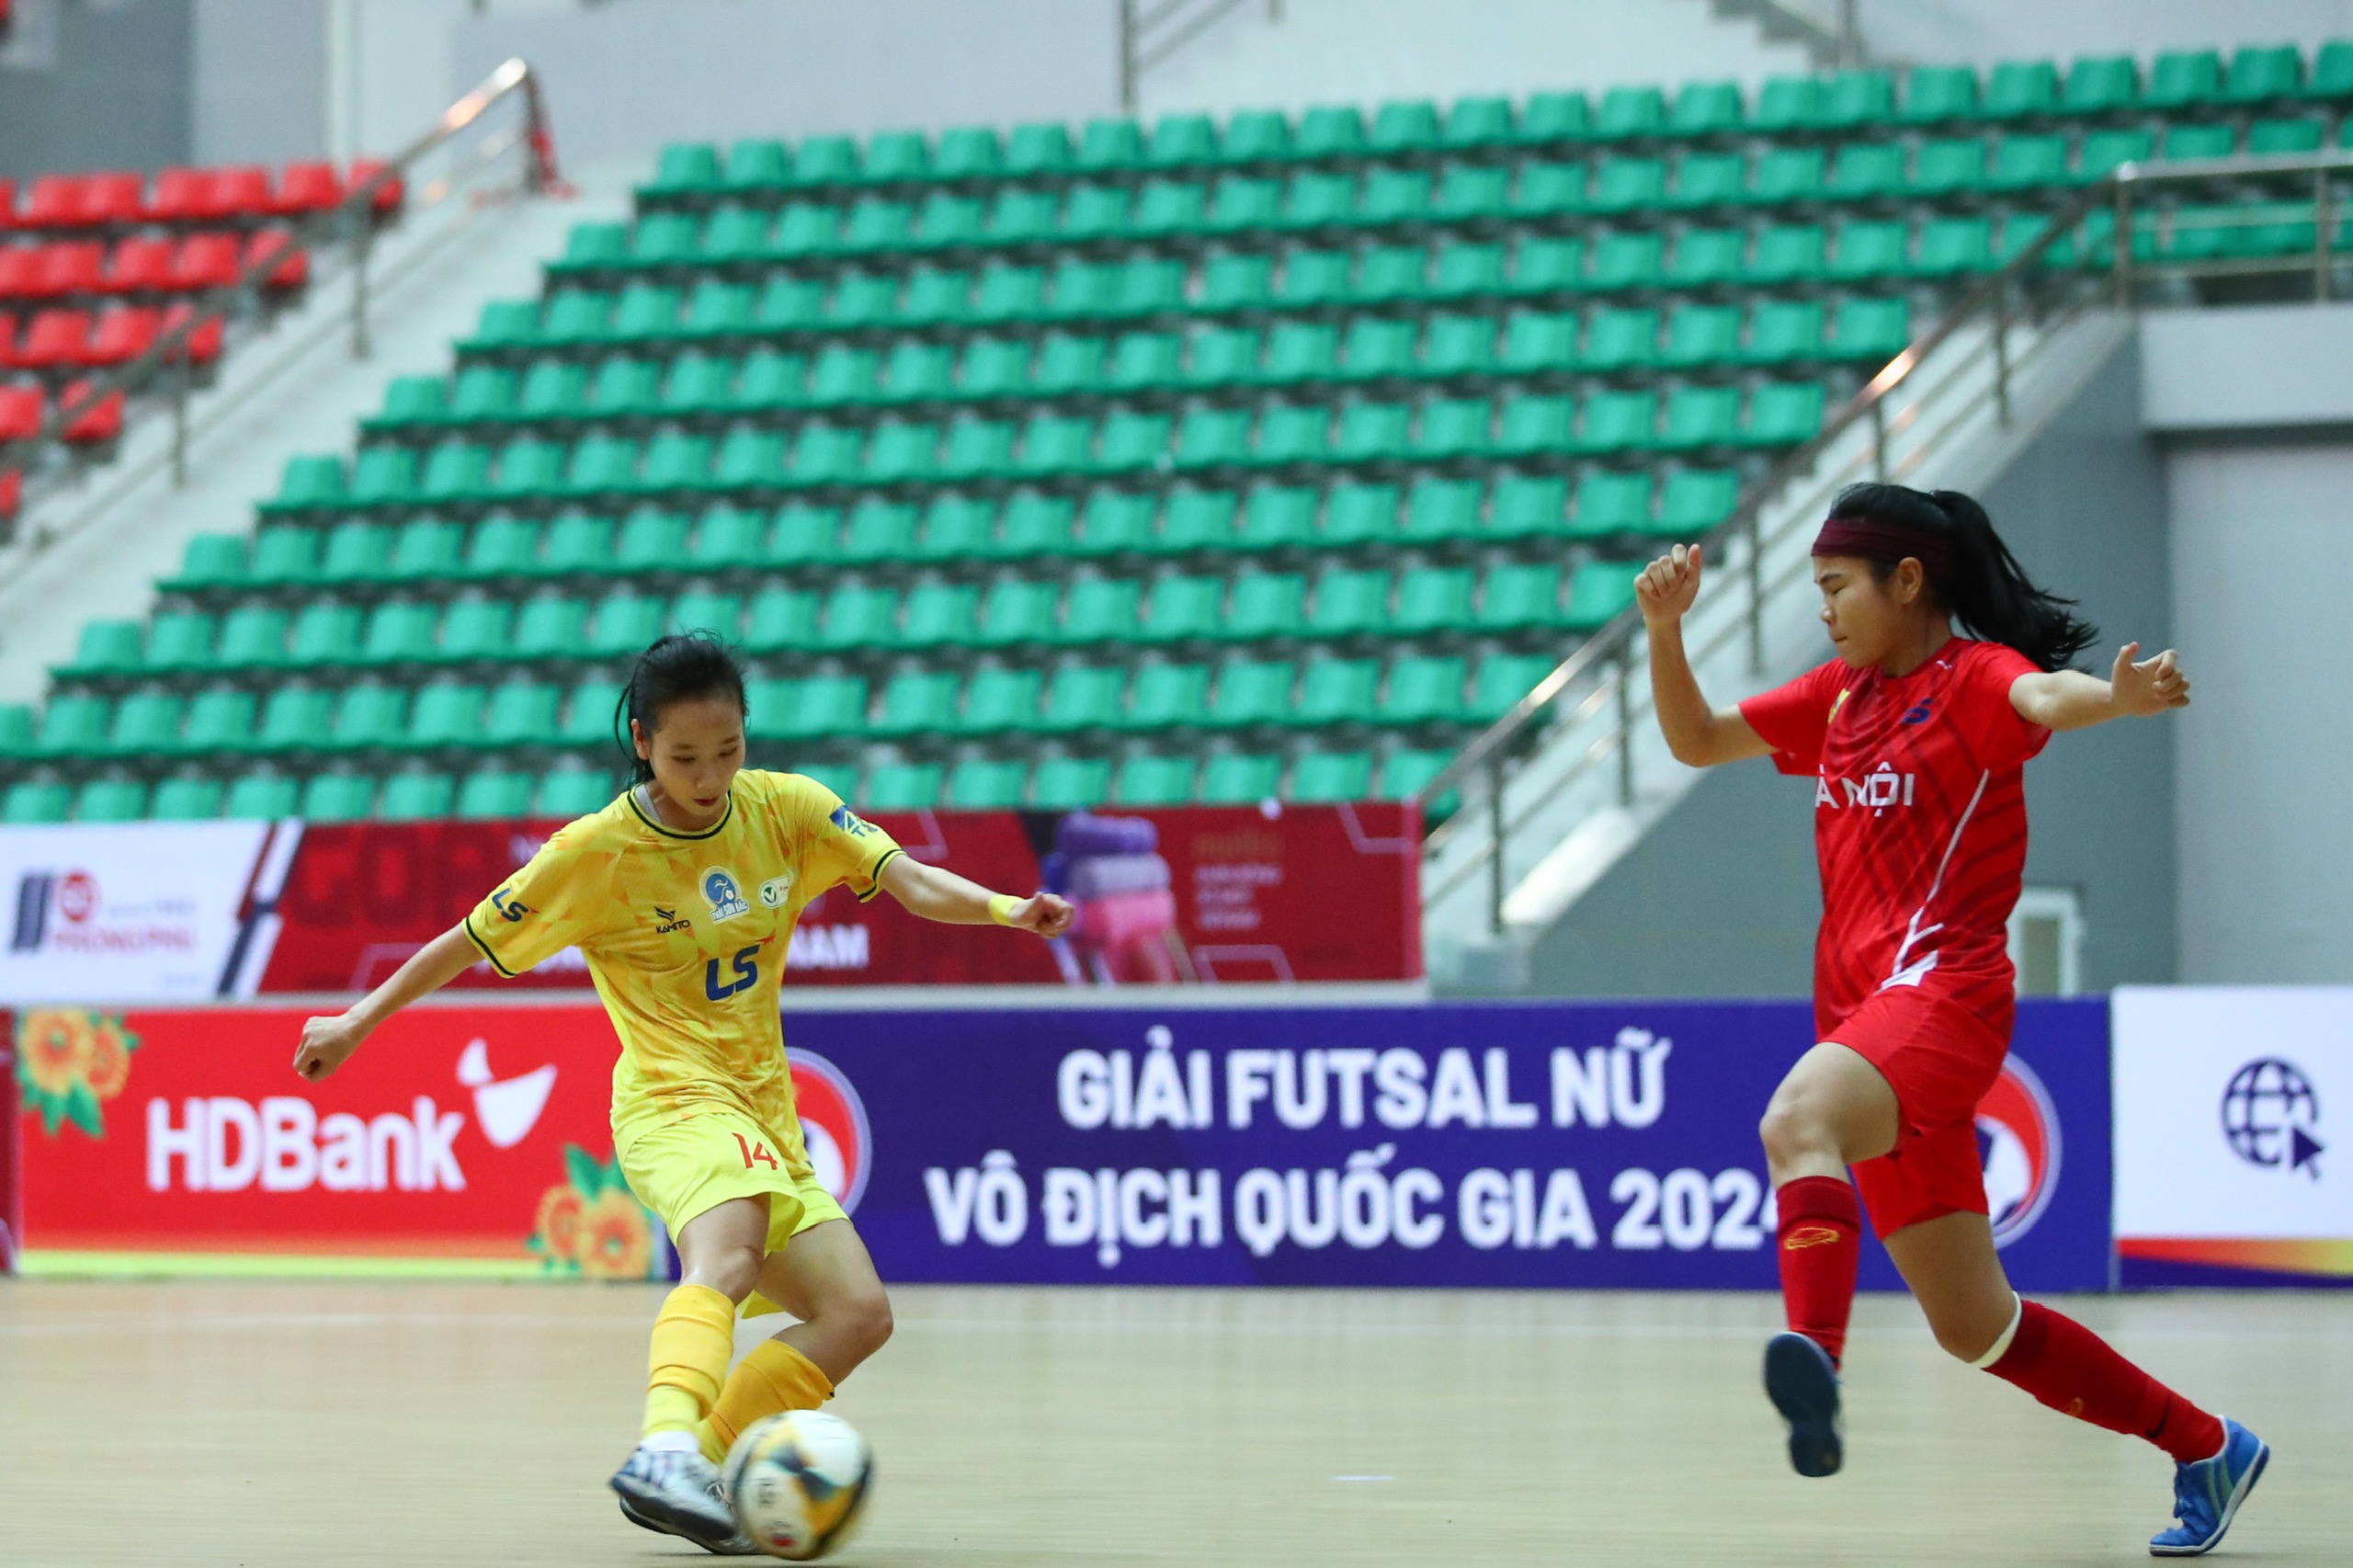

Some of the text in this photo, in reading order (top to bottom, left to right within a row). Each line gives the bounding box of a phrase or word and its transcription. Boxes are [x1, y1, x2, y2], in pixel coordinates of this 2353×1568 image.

[1815, 761, 1915, 817] À NỘI
[492, 887, 529, 922] LS
[655, 919, 691, 935] KAMITO
[706, 944, 761, 1002] LS
[1057, 1025, 1673, 1130] GIẢI FUTSAL NỮ
[146, 1095, 467, 1192] HDBank
[732, 1132, 779, 1170] 14
[924, 1149, 1029, 1246] VÔ
[1040, 1167, 1223, 1268] ĐỊCH
[1233, 1142, 1445, 1257] QUỐC
[1457, 1167, 1598, 1249] GIA
